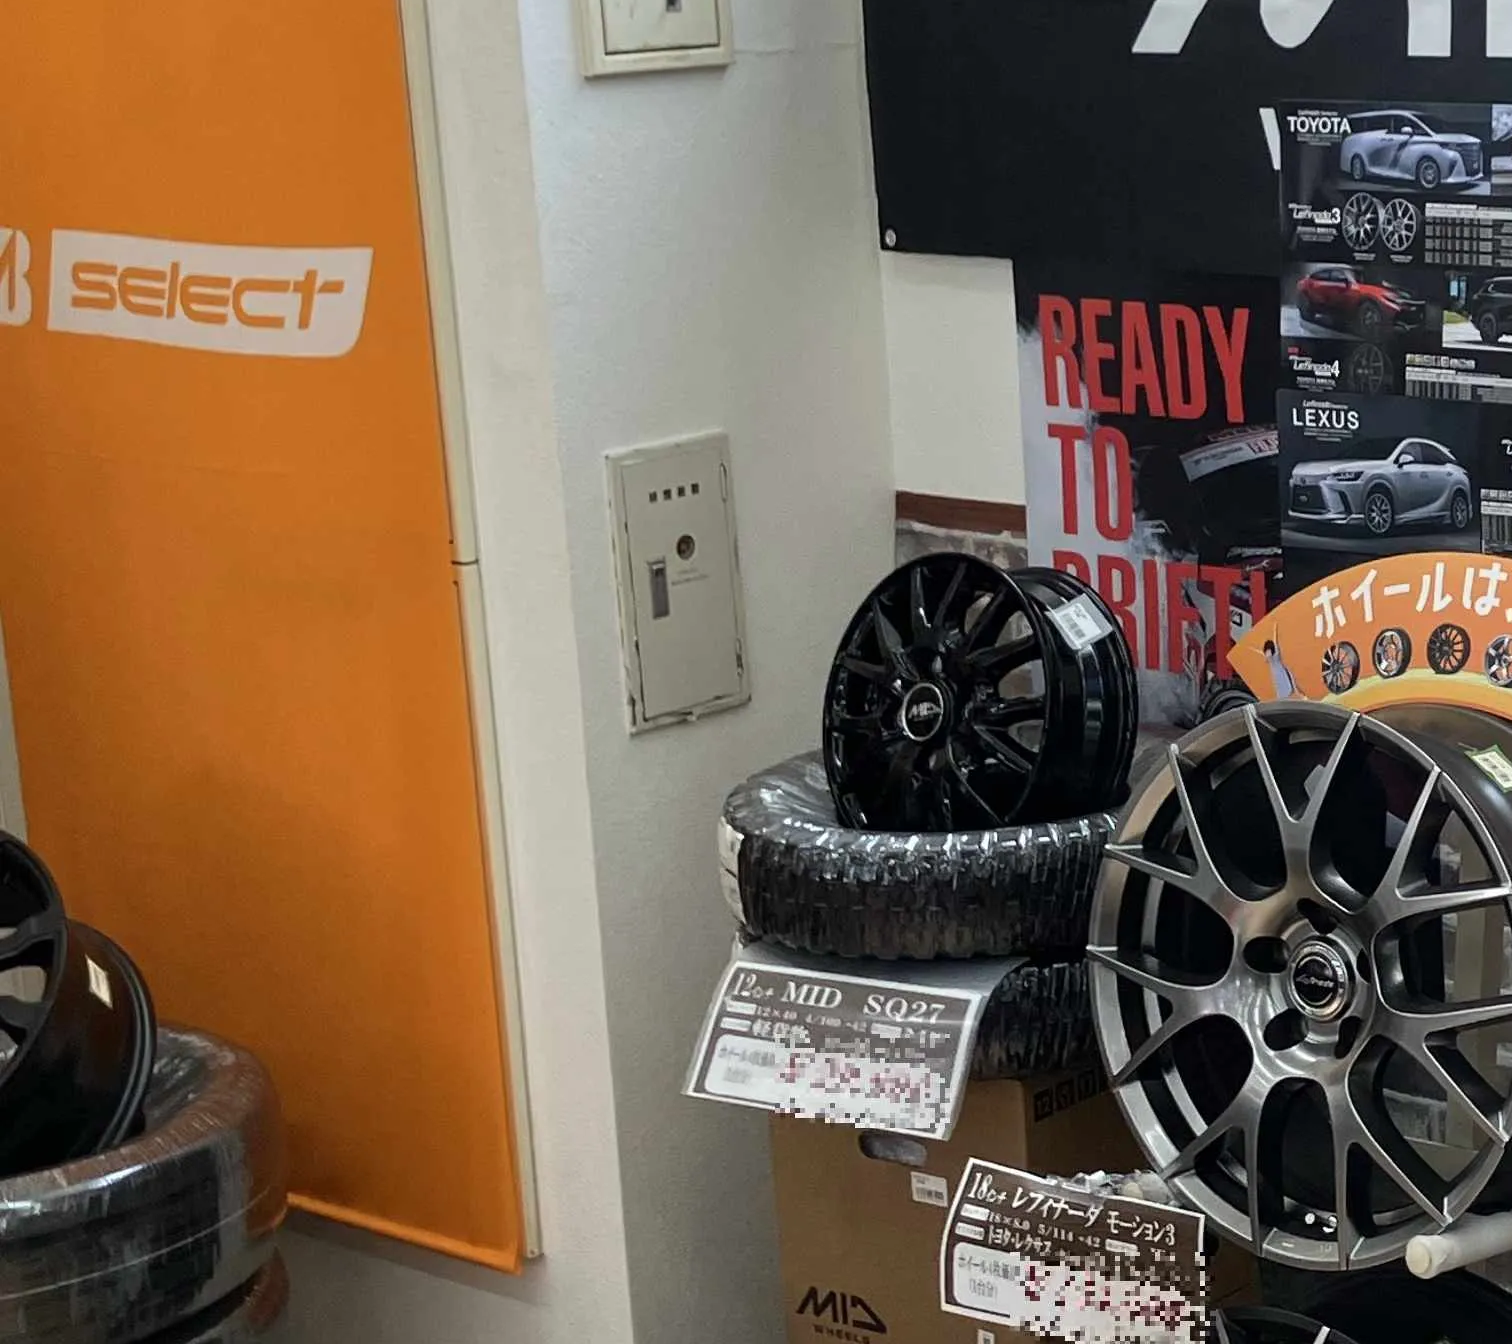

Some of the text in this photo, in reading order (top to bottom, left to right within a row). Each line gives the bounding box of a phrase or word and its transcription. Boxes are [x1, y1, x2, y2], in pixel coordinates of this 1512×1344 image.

[1286, 115, 1352, 134] TOYOTA
[1037, 294, 1250, 425] READY
[1292, 407, 1360, 430] LEXUS
[1047, 424, 1134, 542] TO
[781, 981, 843, 1009] MID
[862, 993, 946, 1025] SQ27
[796, 1286, 888, 1335] MID
